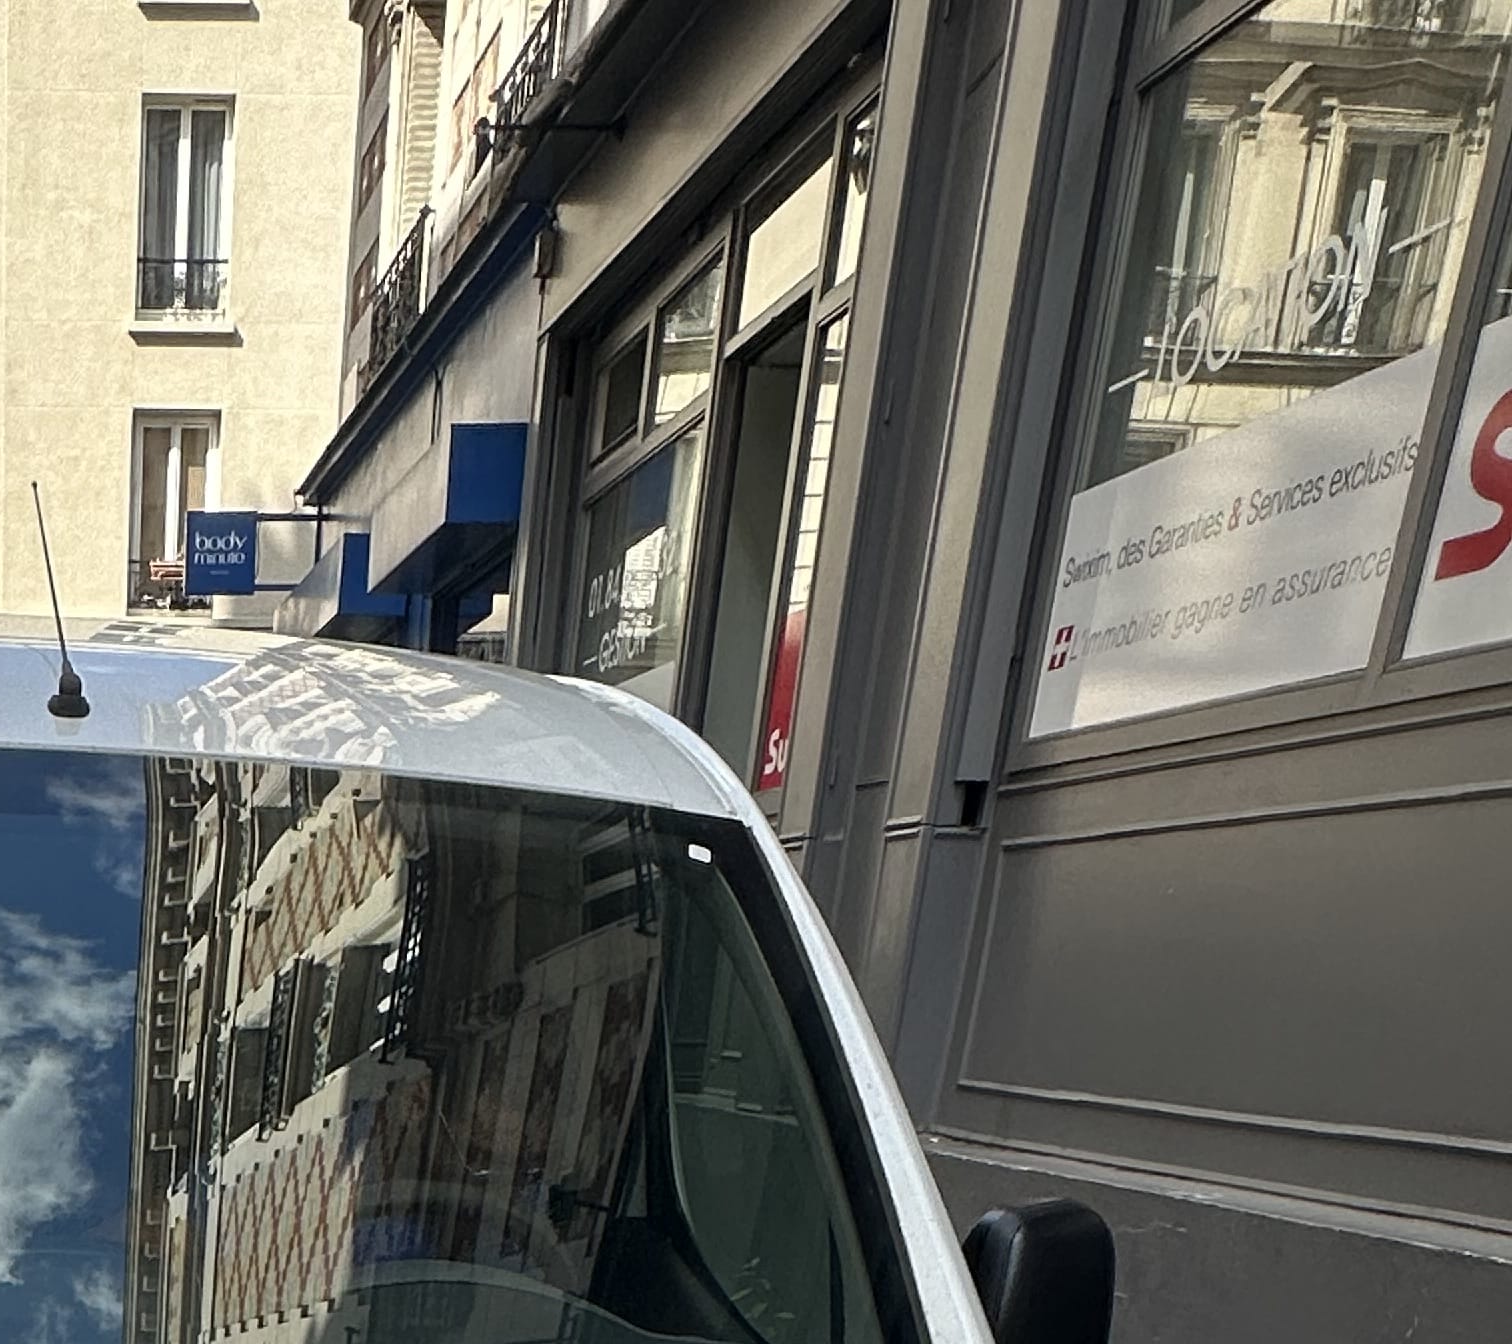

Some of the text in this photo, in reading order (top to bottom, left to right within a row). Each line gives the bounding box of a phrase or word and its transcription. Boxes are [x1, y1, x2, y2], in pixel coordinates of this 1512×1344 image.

[1151, 206, 1389, 396] LOCTON
[194, 530, 248, 551] body
[1117, 536, 1146, 570] des
[1148, 511, 1224, 559] Garanties
[1227, 497, 1242, 532] &
[1247, 475, 1324, 526] Services
[1327, 434, 1420, 498] exclusifs
[1170, 591, 1235, 640] gagne
[1239, 582, 1268, 614] en
[1271, 546, 1393, 606] assurance
